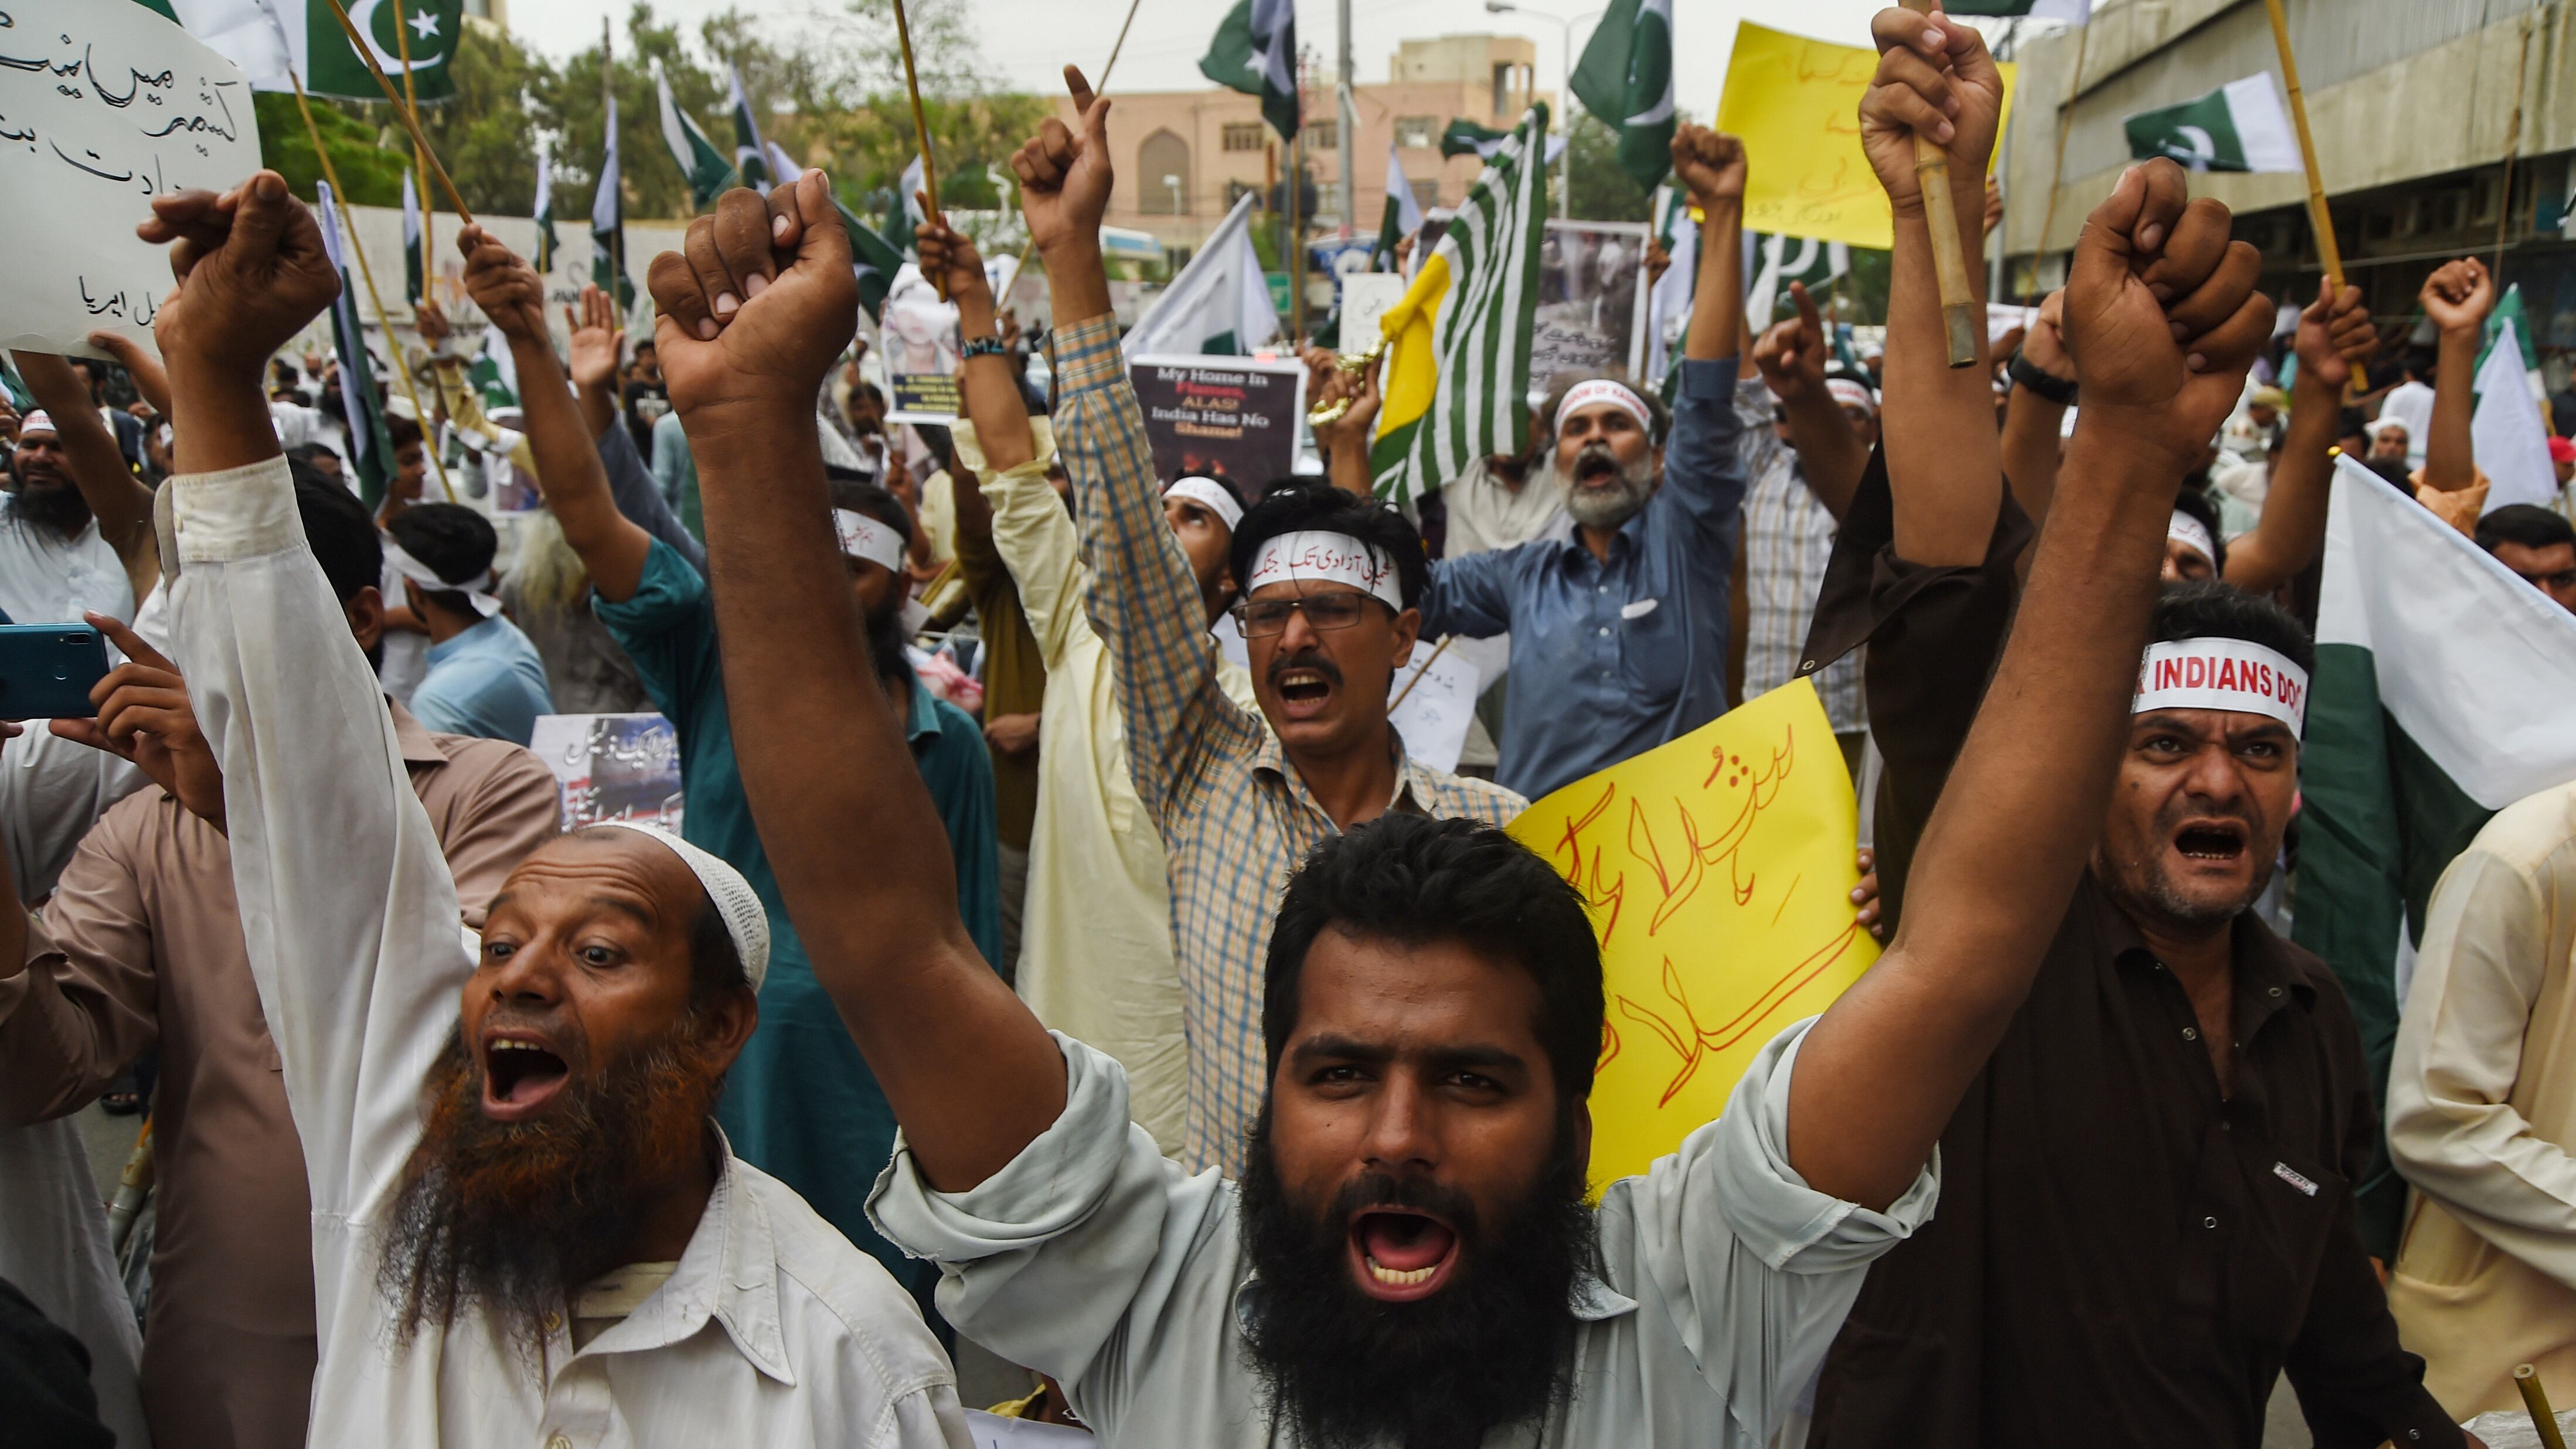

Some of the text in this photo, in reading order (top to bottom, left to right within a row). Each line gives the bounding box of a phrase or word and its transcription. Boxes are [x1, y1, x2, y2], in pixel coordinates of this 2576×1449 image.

[86, 43, 173, 107] میں
[1158, 367, 1187, 383] My
[1190, 369, 1246, 385] Home
[1152, 407, 1270, 428] India Has No
[1316, 549, 1362, 572] آزادی
[2155, 657, 2272, 697] INDIANS
